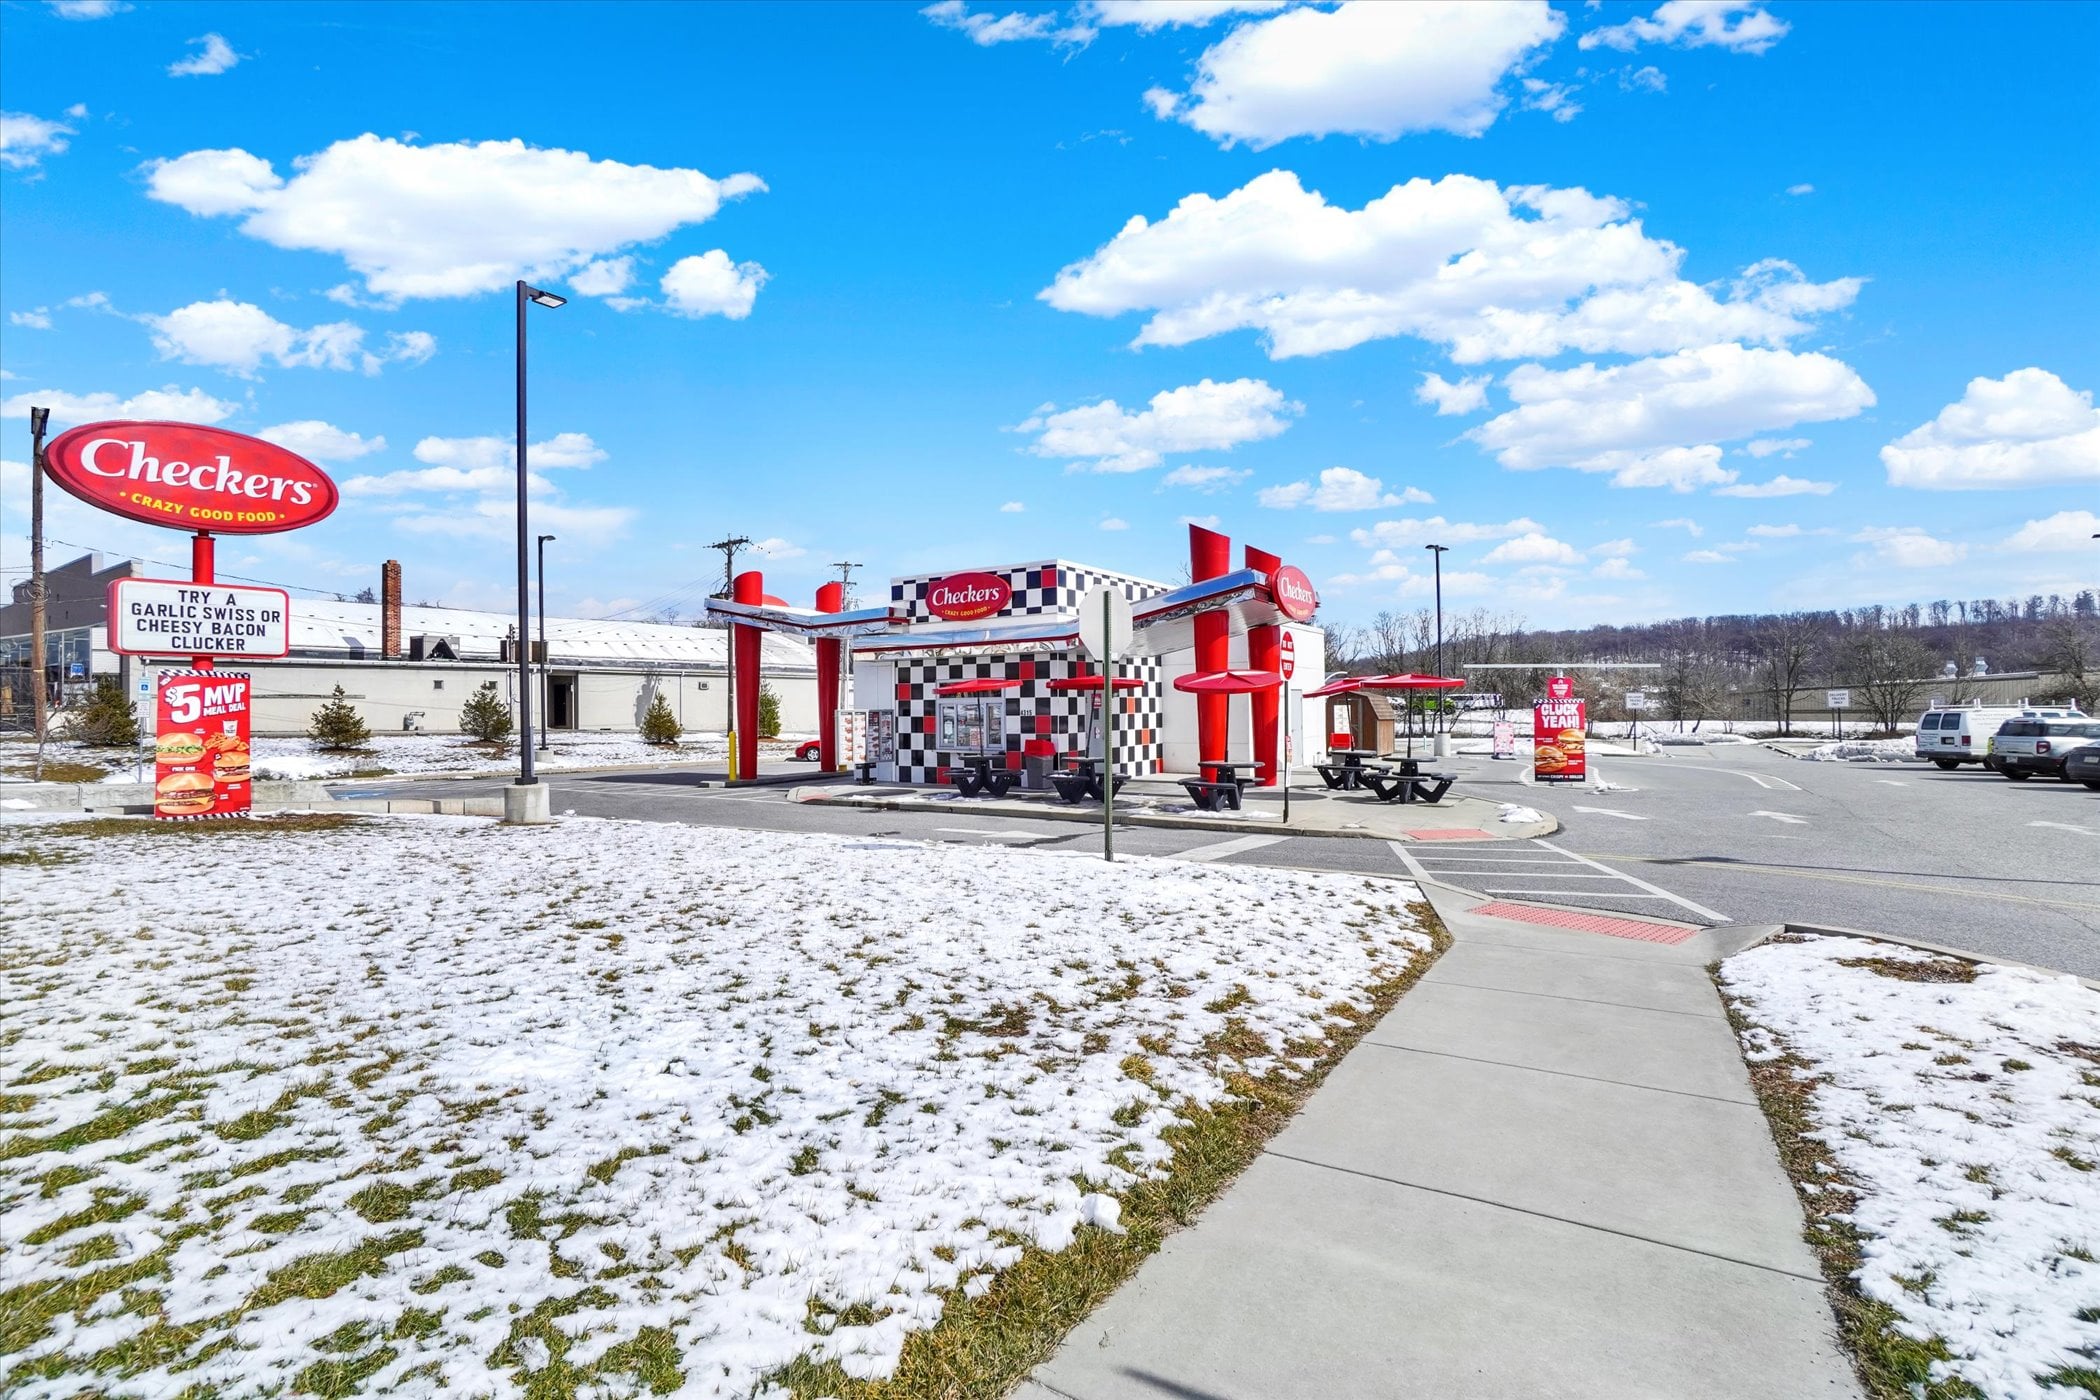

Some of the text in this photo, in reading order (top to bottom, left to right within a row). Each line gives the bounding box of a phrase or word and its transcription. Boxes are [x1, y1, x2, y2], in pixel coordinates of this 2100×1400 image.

[80, 438, 313, 505] Checkers
[131, 493, 276, 523] CRAZY GOOD FOOD
[178, 590, 237, 606] TRY A
[932, 584, 1000, 606] Checkers
[1281, 577, 1312, 604] Checkers
[131, 602, 280, 624] GARLIC SWISS OR
[974, 606, 988, 615] FOOD
[137, 618, 266, 637] CHEESY BACON
[171, 635, 245, 651] CLUCKER
[164, 683, 201, 723] $5
[204, 683, 246, 707] MVP
[203, 702, 246, 717] MEAL DEAL
[1541, 704, 1579, 715] CLUCK
[1541, 716, 1580, 728] YEAH!
